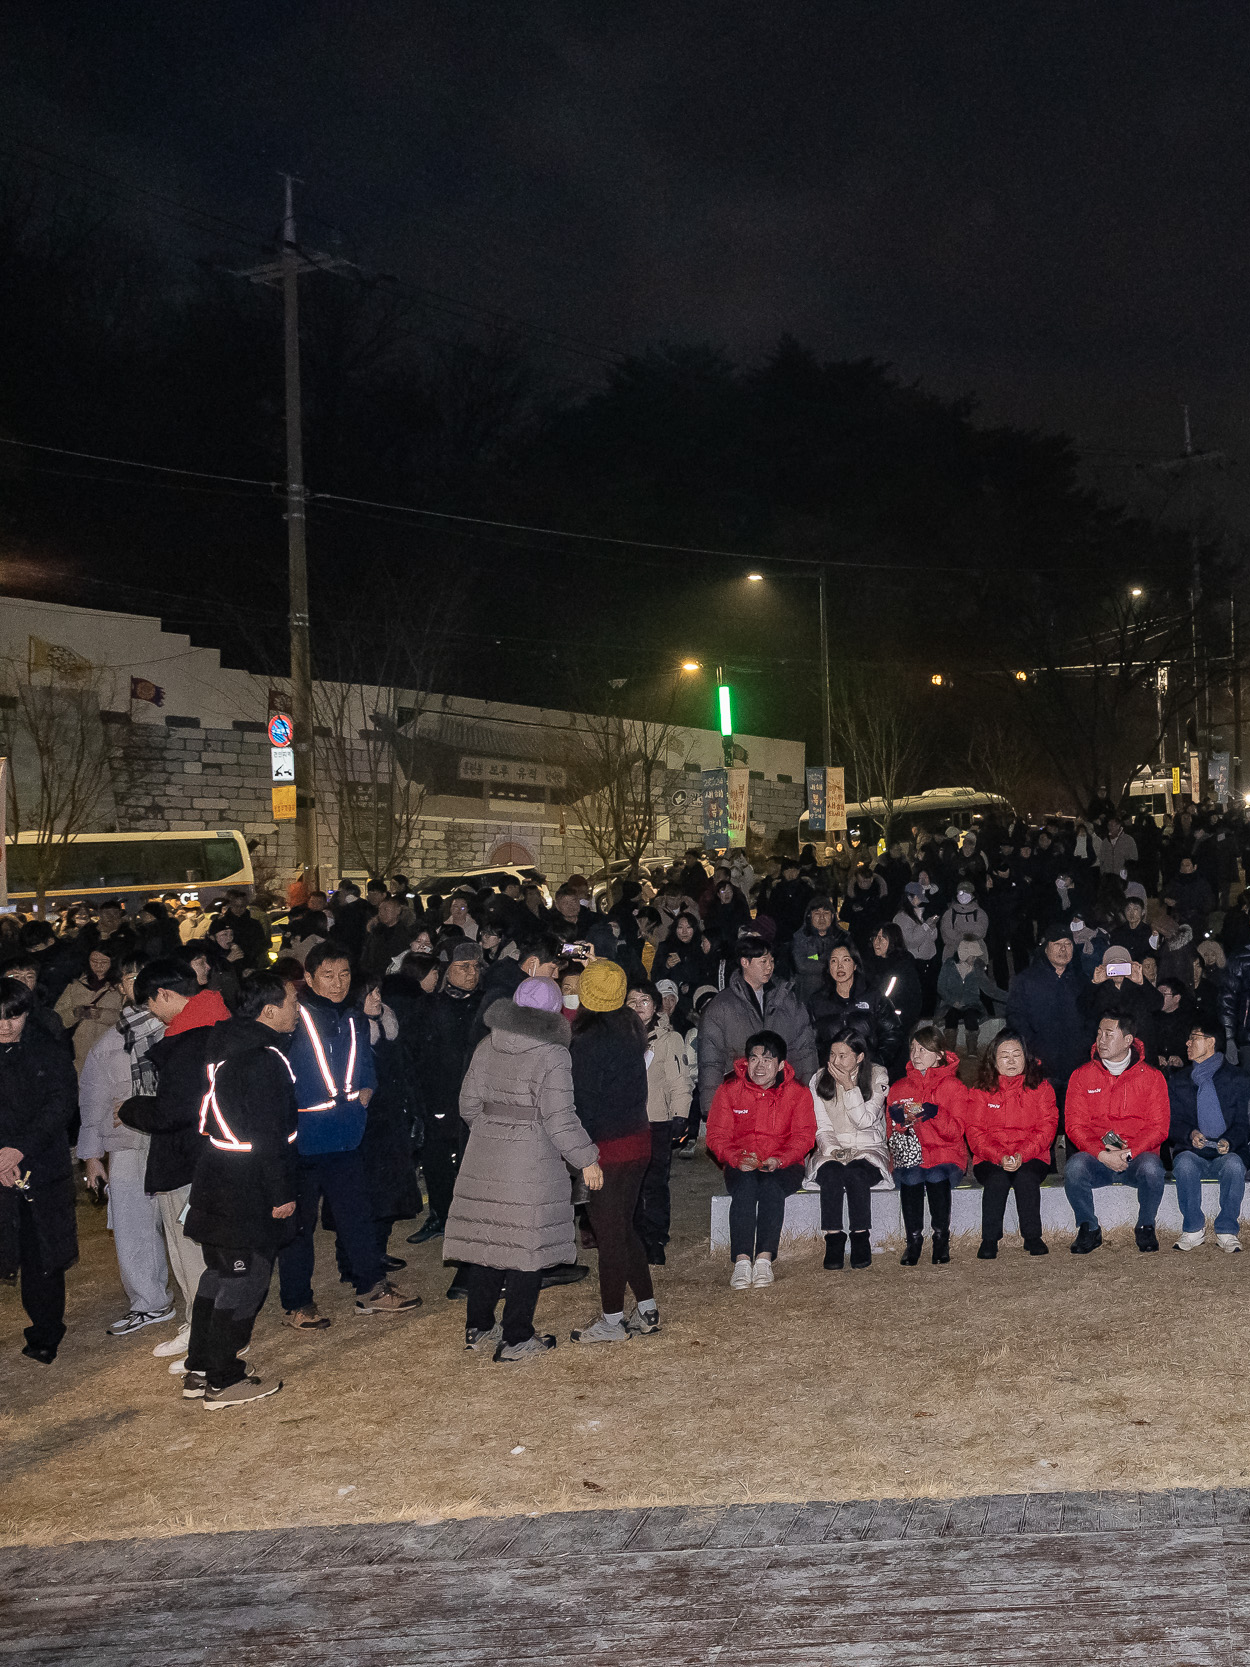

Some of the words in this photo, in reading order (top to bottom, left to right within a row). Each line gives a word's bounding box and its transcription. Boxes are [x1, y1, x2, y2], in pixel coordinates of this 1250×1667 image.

[489, 764, 509, 777] 보루
[516, 766, 537, 781] 유적
[704, 789, 724, 799] 새해
[710, 803, 717, 818] 복
[827, 802, 845, 811] 새해
[729, 811, 746, 823] 새해
[708, 819, 722, 829] 많이
